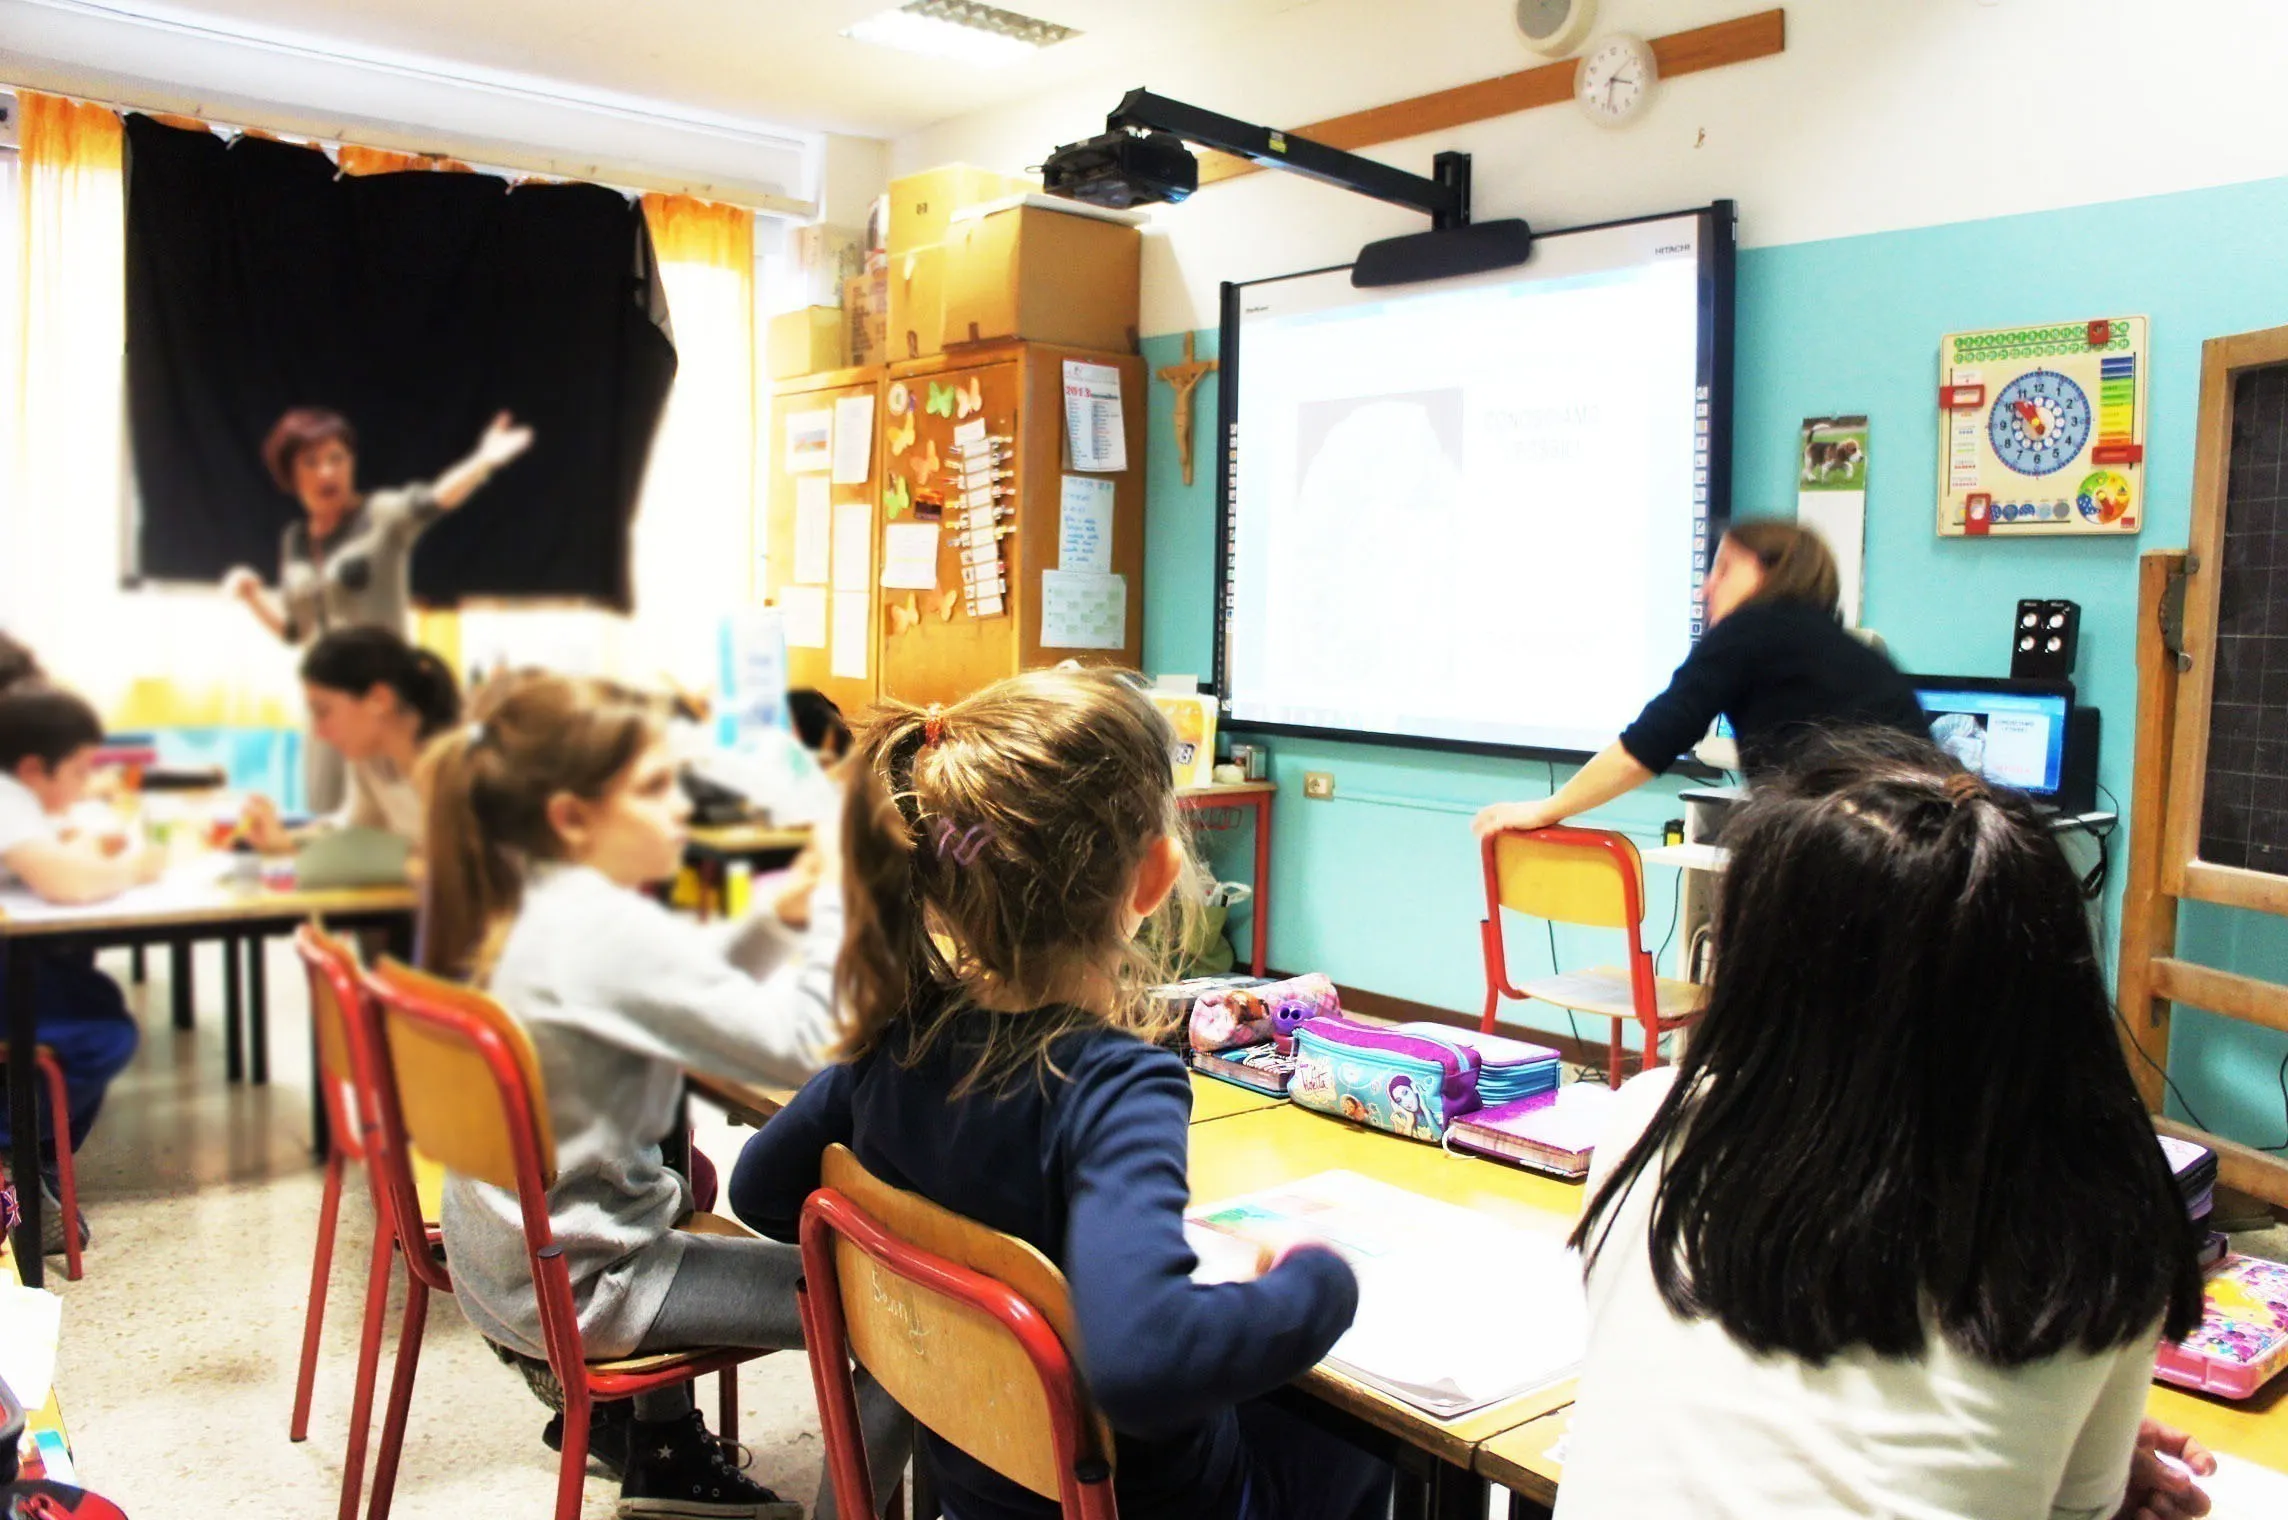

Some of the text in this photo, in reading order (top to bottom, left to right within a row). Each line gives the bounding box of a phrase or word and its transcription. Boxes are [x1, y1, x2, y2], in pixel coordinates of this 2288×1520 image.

[1654, 243, 1691, 255] HITACHI
[1065, 385, 1091, 398] 2013
[2034, 383, 2045, 393] 12
[2057, 387, 2061, 396] 1
[2017, 389, 2027, 398] 11
[2066, 399, 2073, 409] 2
[1999, 420, 2007, 431] 9
[2071, 417, 2078, 427] 3
[2004, 438, 2011, 448] 8
[2065, 436, 2072, 445] 4
[2017, 450, 2023, 460] 7
[2052, 448, 2060, 458] 5
[2034, 454, 2041, 464] 6
